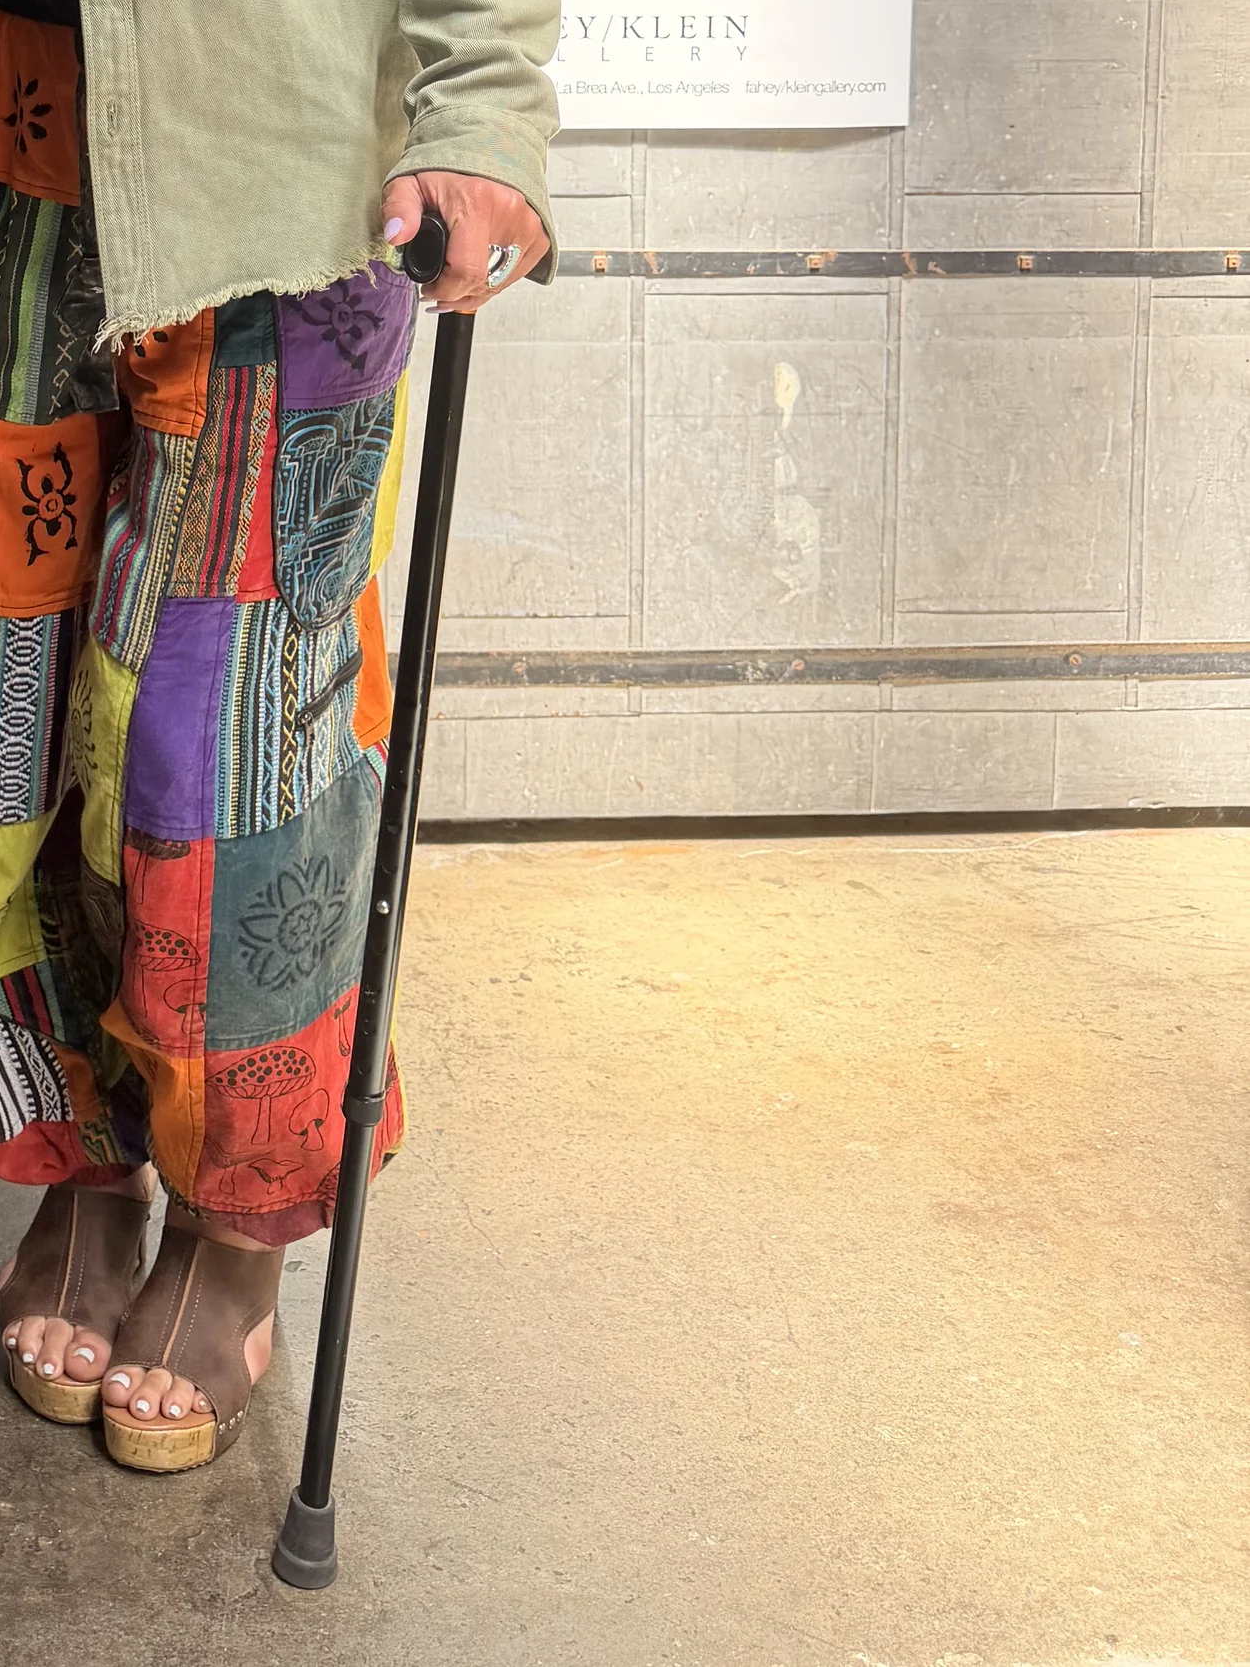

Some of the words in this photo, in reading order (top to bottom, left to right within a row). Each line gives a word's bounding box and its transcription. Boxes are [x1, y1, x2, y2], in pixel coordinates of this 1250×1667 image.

[576, 81, 607, 94] Brea
[648, 81, 673, 94] Los
[676, 81, 730, 97] Angeles
